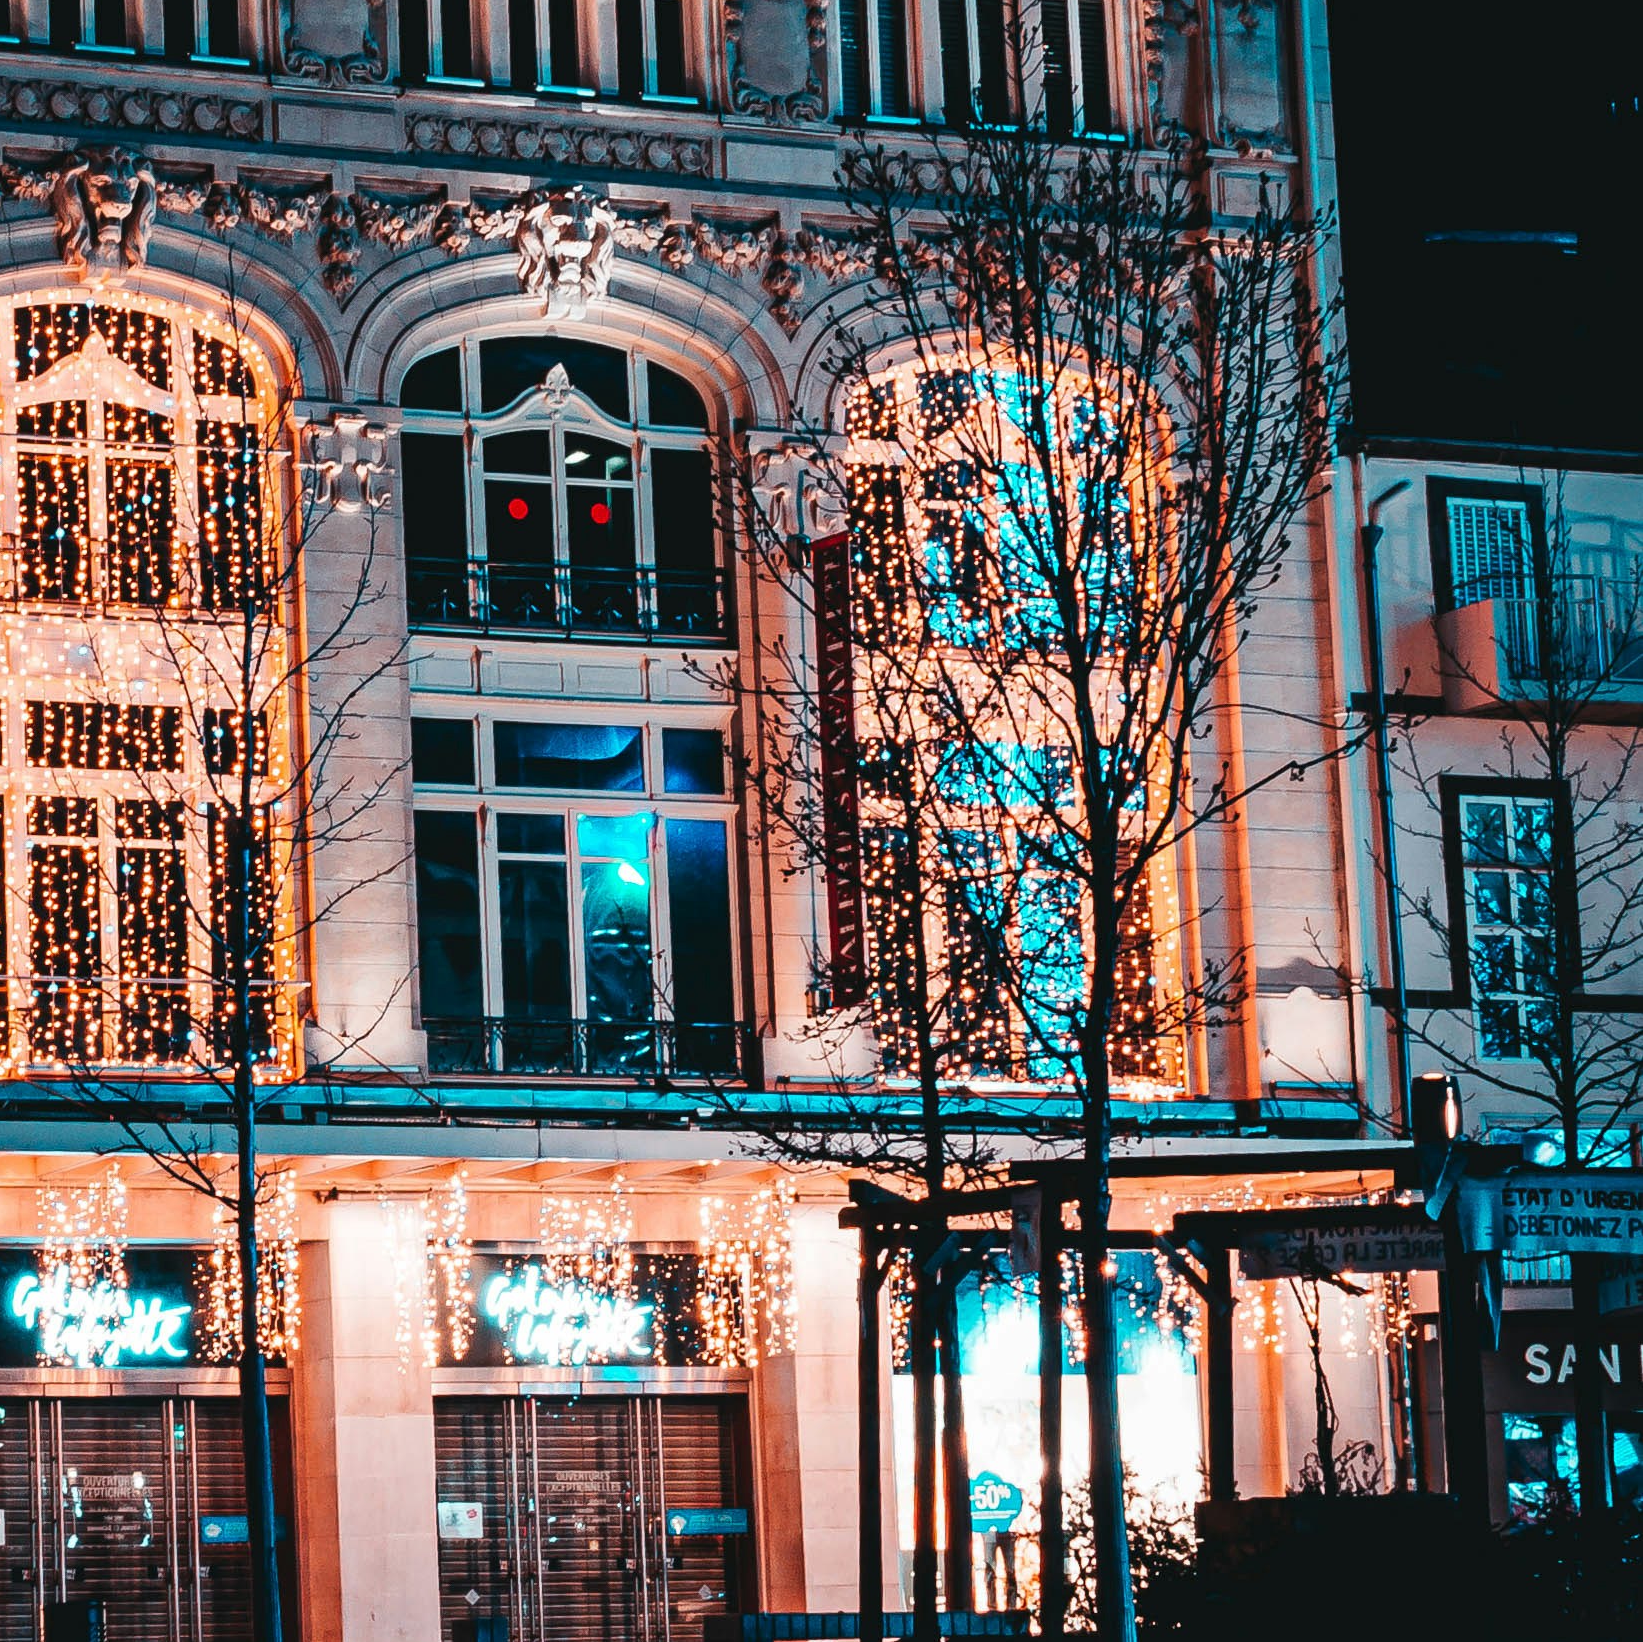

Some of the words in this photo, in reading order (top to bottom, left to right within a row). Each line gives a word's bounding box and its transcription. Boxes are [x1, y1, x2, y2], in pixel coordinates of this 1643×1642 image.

[1501, 1182, 1554, 1208] ÉTAT
[13, 1265, 132, 1329] Galeries
[485, 1265, 594, 1328] Galeries
[1525, 1343, 1622, 1384] SAN
